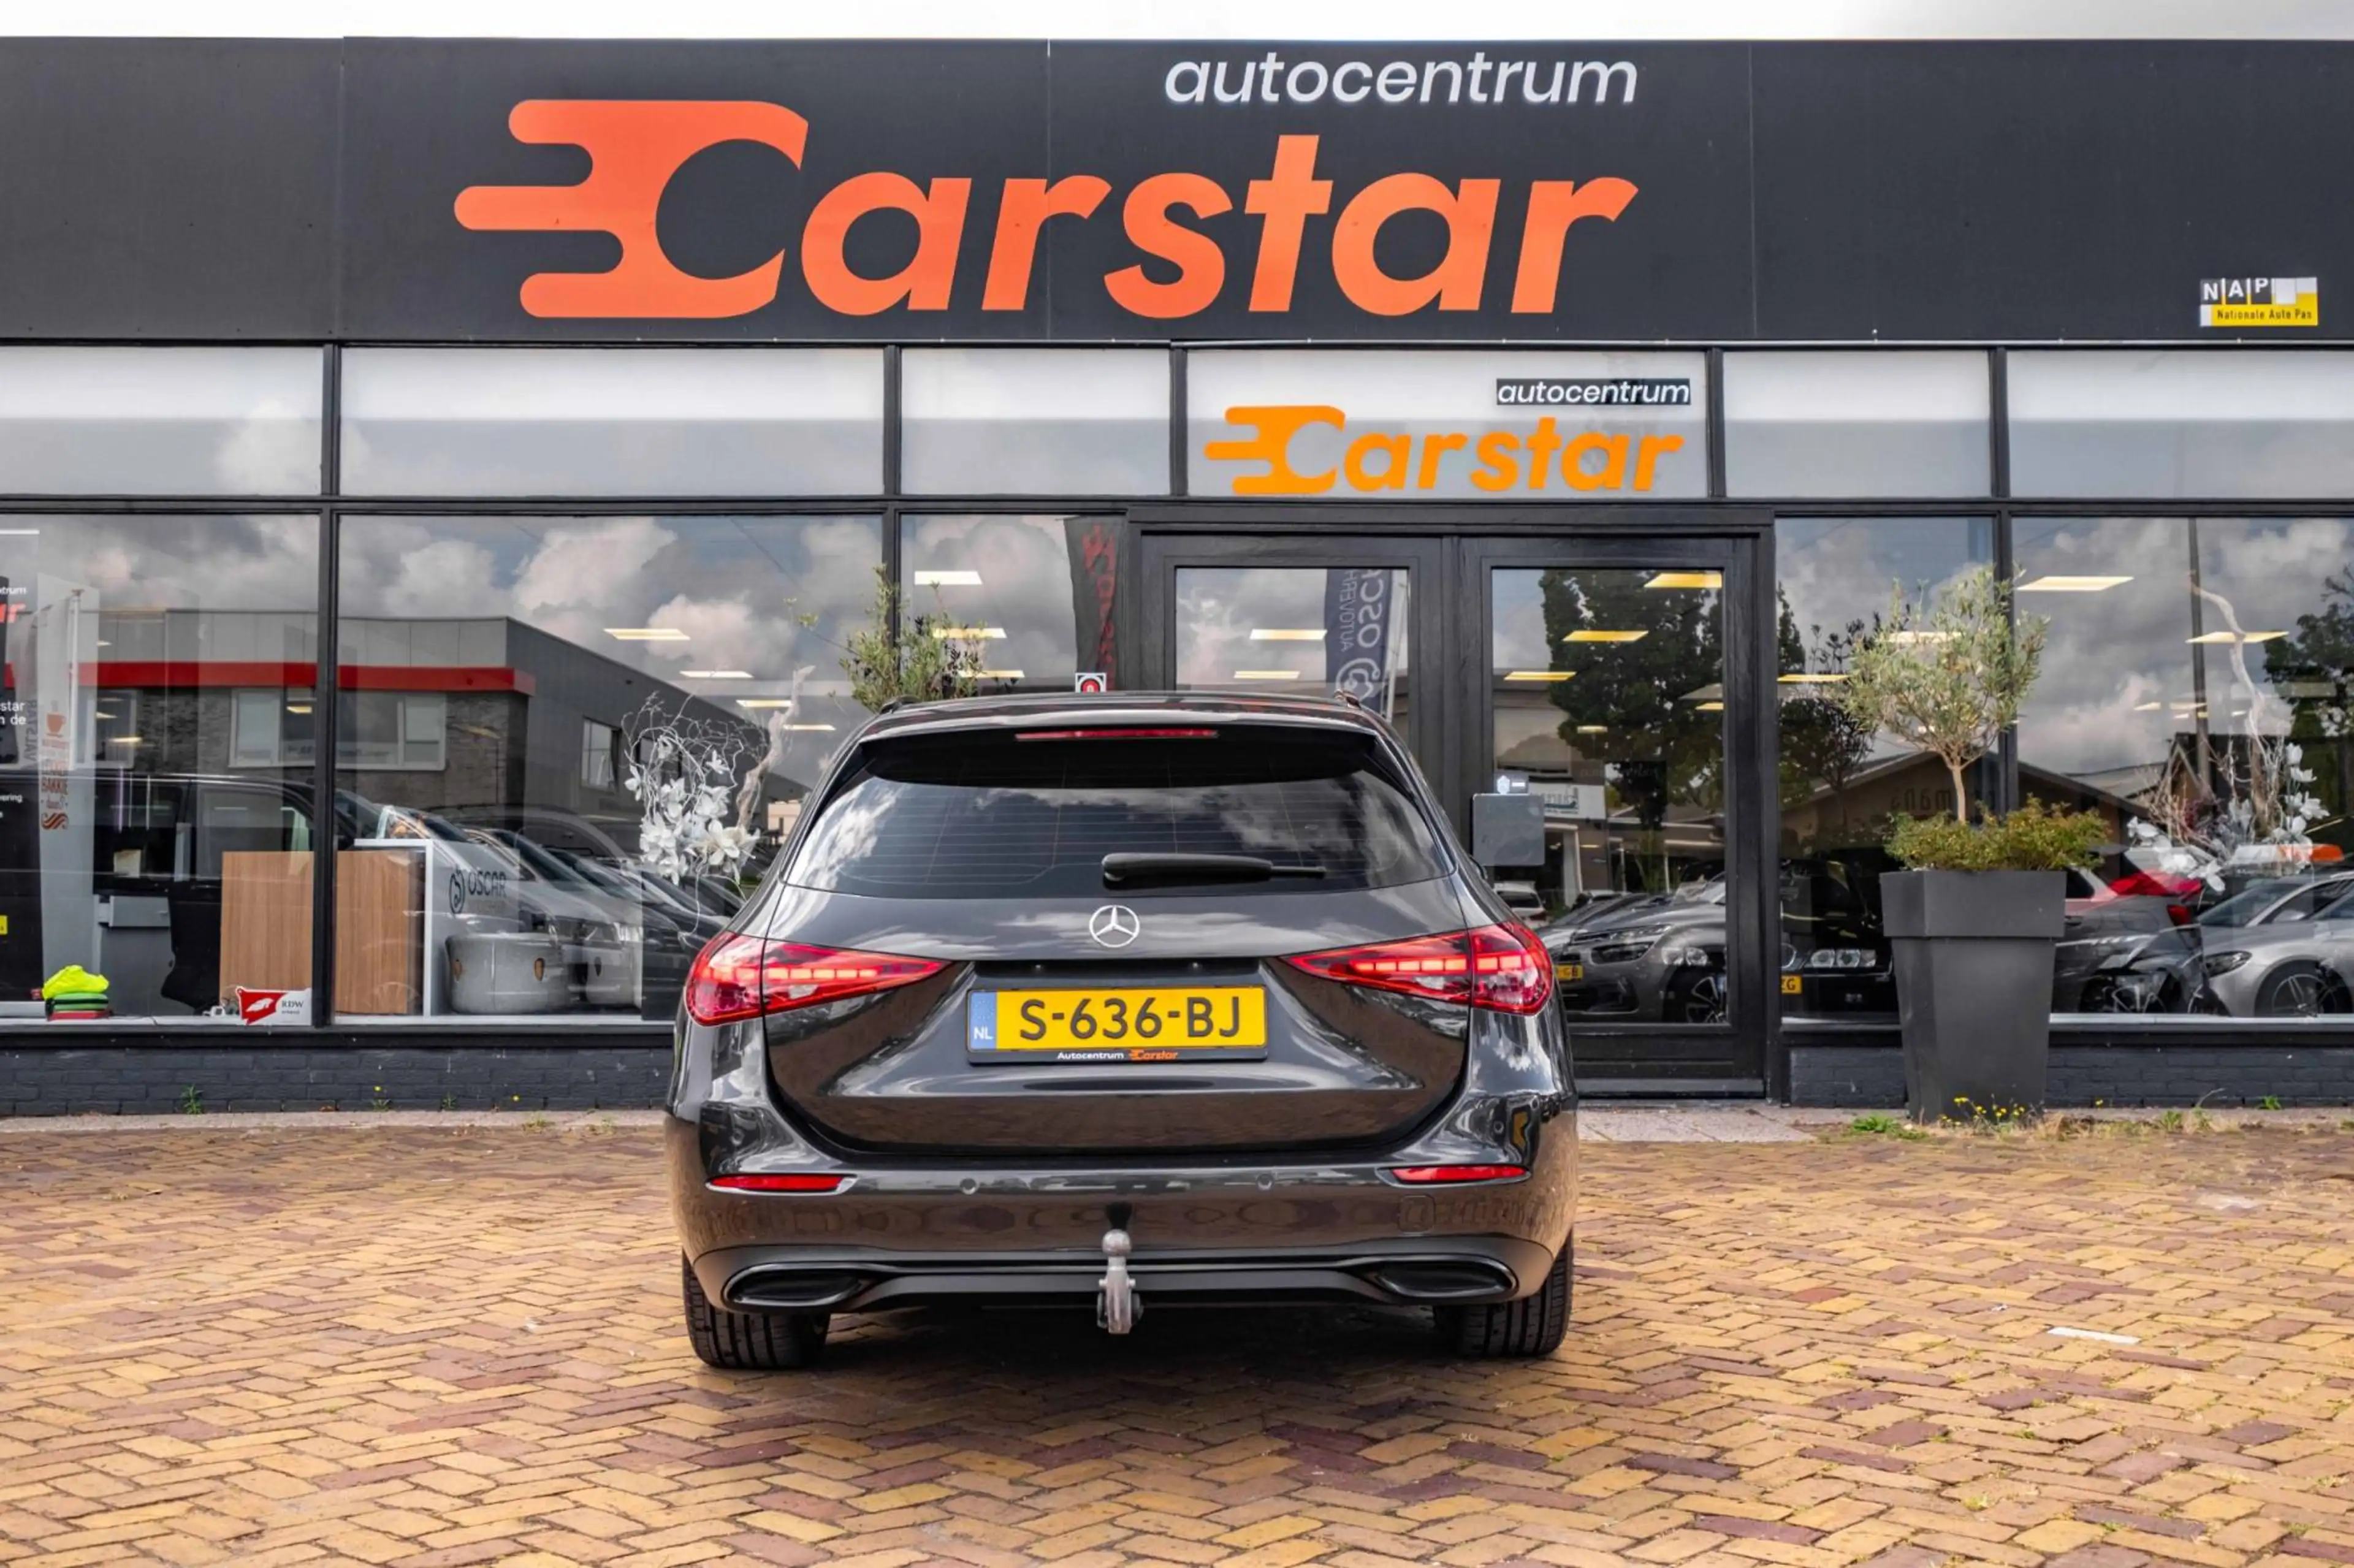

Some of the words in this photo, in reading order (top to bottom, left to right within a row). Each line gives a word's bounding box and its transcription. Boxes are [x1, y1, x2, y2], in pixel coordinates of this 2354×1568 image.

[1165, 52, 1637, 103] autocentrum
[454, 99, 1639, 319] Carstar
[2217, 309, 2264, 319] Nationale
[2269, 308, 2291, 319] Auto
[2295, 308, 2312, 319] Pas
[1498, 381, 1689, 403] autocentrum
[1203, 405, 1685, 495] Carstar
[468, 871, 507, 897] OSCAR
[973, 1026, 992, 1040] NL
[1019, 997, 1240, 1040] S-636-BJ
[1057, 1051, 1125, 1060] Autocentrum
[1129, 1049, 1178, 1061] Carstar
